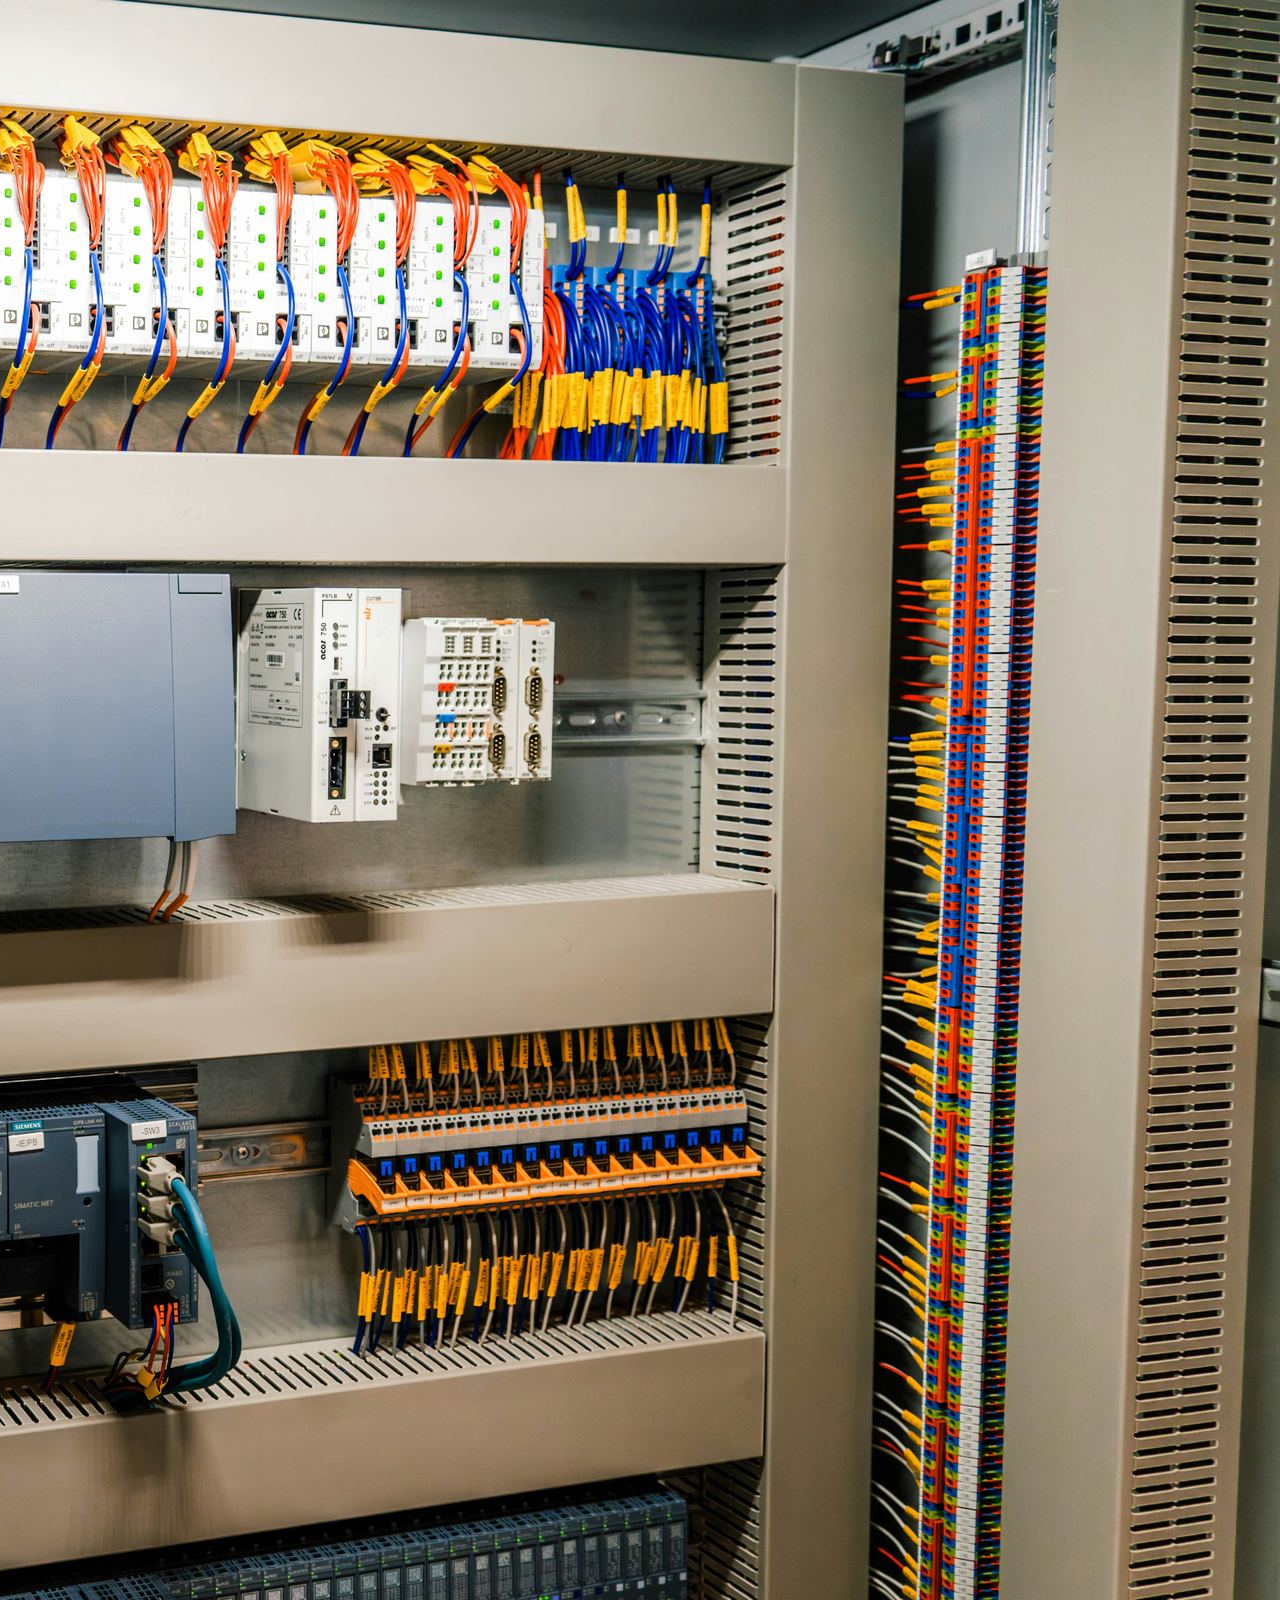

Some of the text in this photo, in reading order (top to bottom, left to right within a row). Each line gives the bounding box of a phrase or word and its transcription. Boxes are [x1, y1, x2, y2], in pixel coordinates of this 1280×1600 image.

[168, 1120, 195, 1128] SCALANCE
[141, 1127, 160, 1135] -SW3
[16, 1139, 37, 1148] -IE/PB
[14, 1201, 40, 1210] SIMATIC
